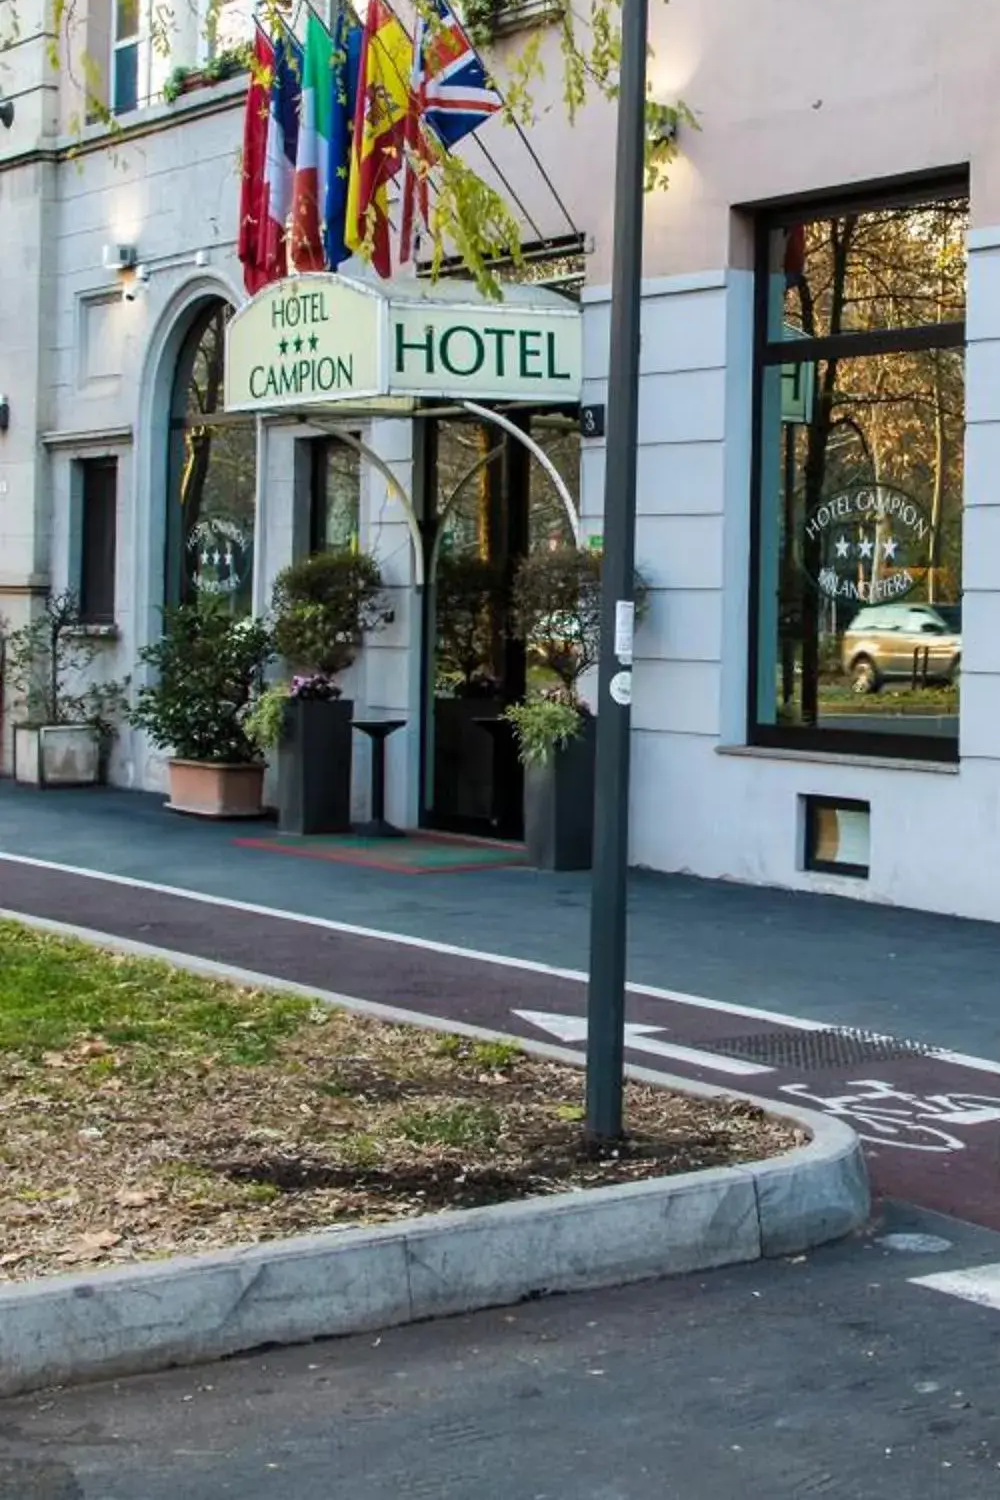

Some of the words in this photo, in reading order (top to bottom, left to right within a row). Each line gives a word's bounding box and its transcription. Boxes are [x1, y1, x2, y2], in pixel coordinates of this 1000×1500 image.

[271, 291, 329, 329] HOTEL
[395, 322, 571, 381] HOTEL
[249, 353, 354, 399] CAMPION
[805, 496, 853, 541] HOTEL
[856, 490, 929, 540] CAMPION
